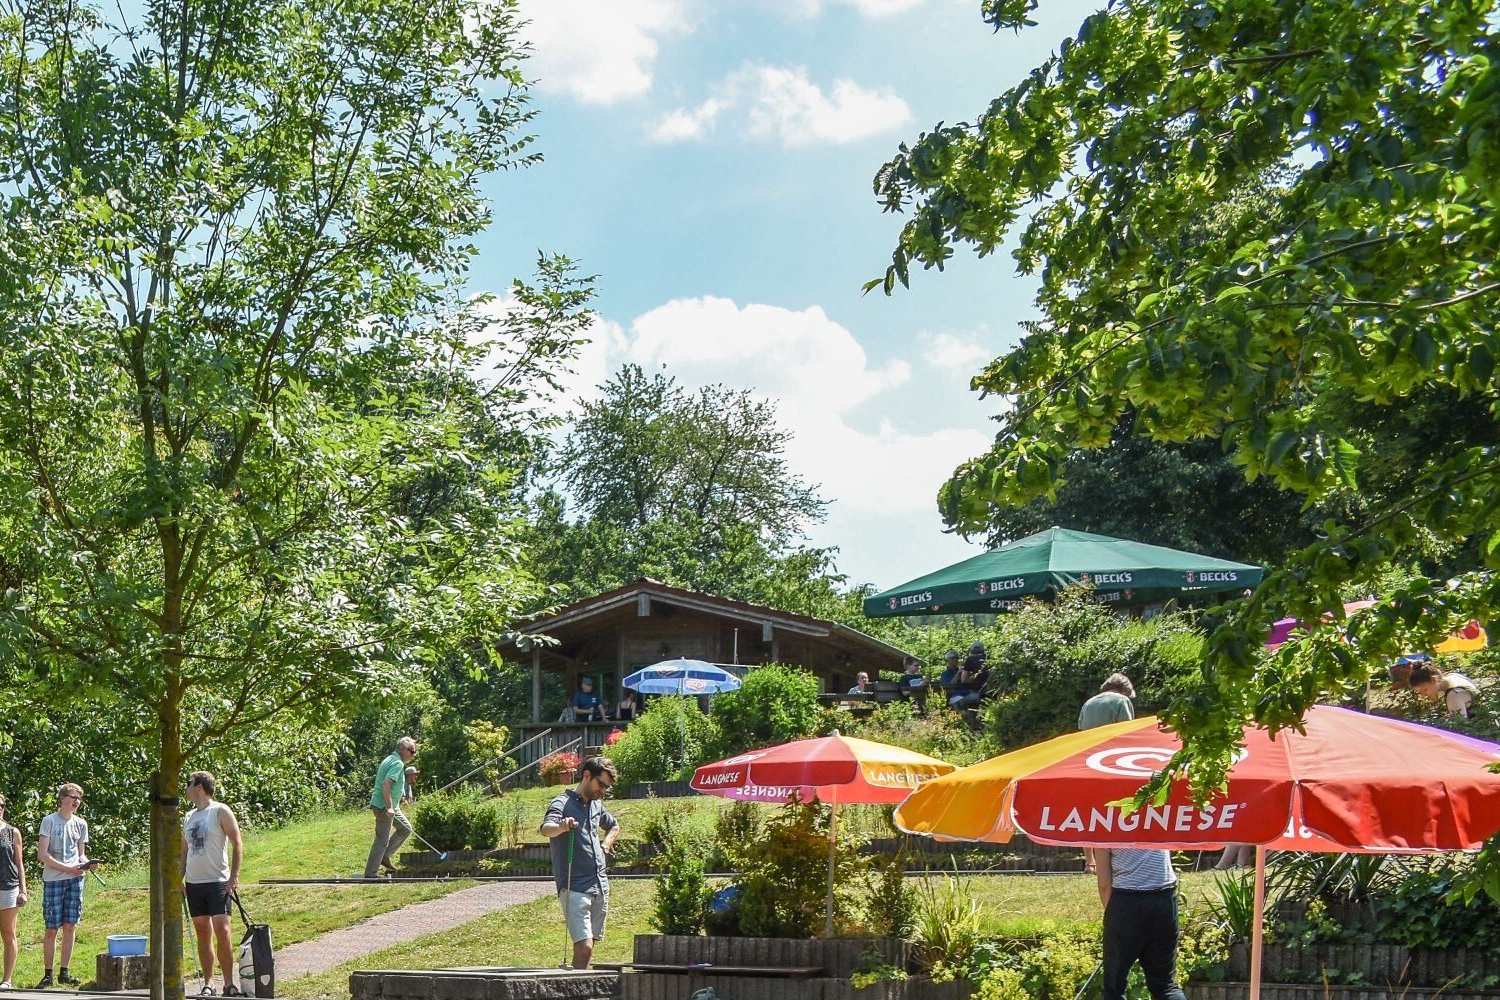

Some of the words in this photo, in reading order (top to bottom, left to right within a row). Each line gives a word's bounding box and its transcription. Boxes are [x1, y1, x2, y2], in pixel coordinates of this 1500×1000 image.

[1094, 571, 1132, 583] BECK'S
[1200, 570, 1238, 582] BECK'S
[990, 576, 1025, 591] BECK'S
[900, 591, 933, 606] BECK'S
[699, 772, 741, 785] LANGNESE
